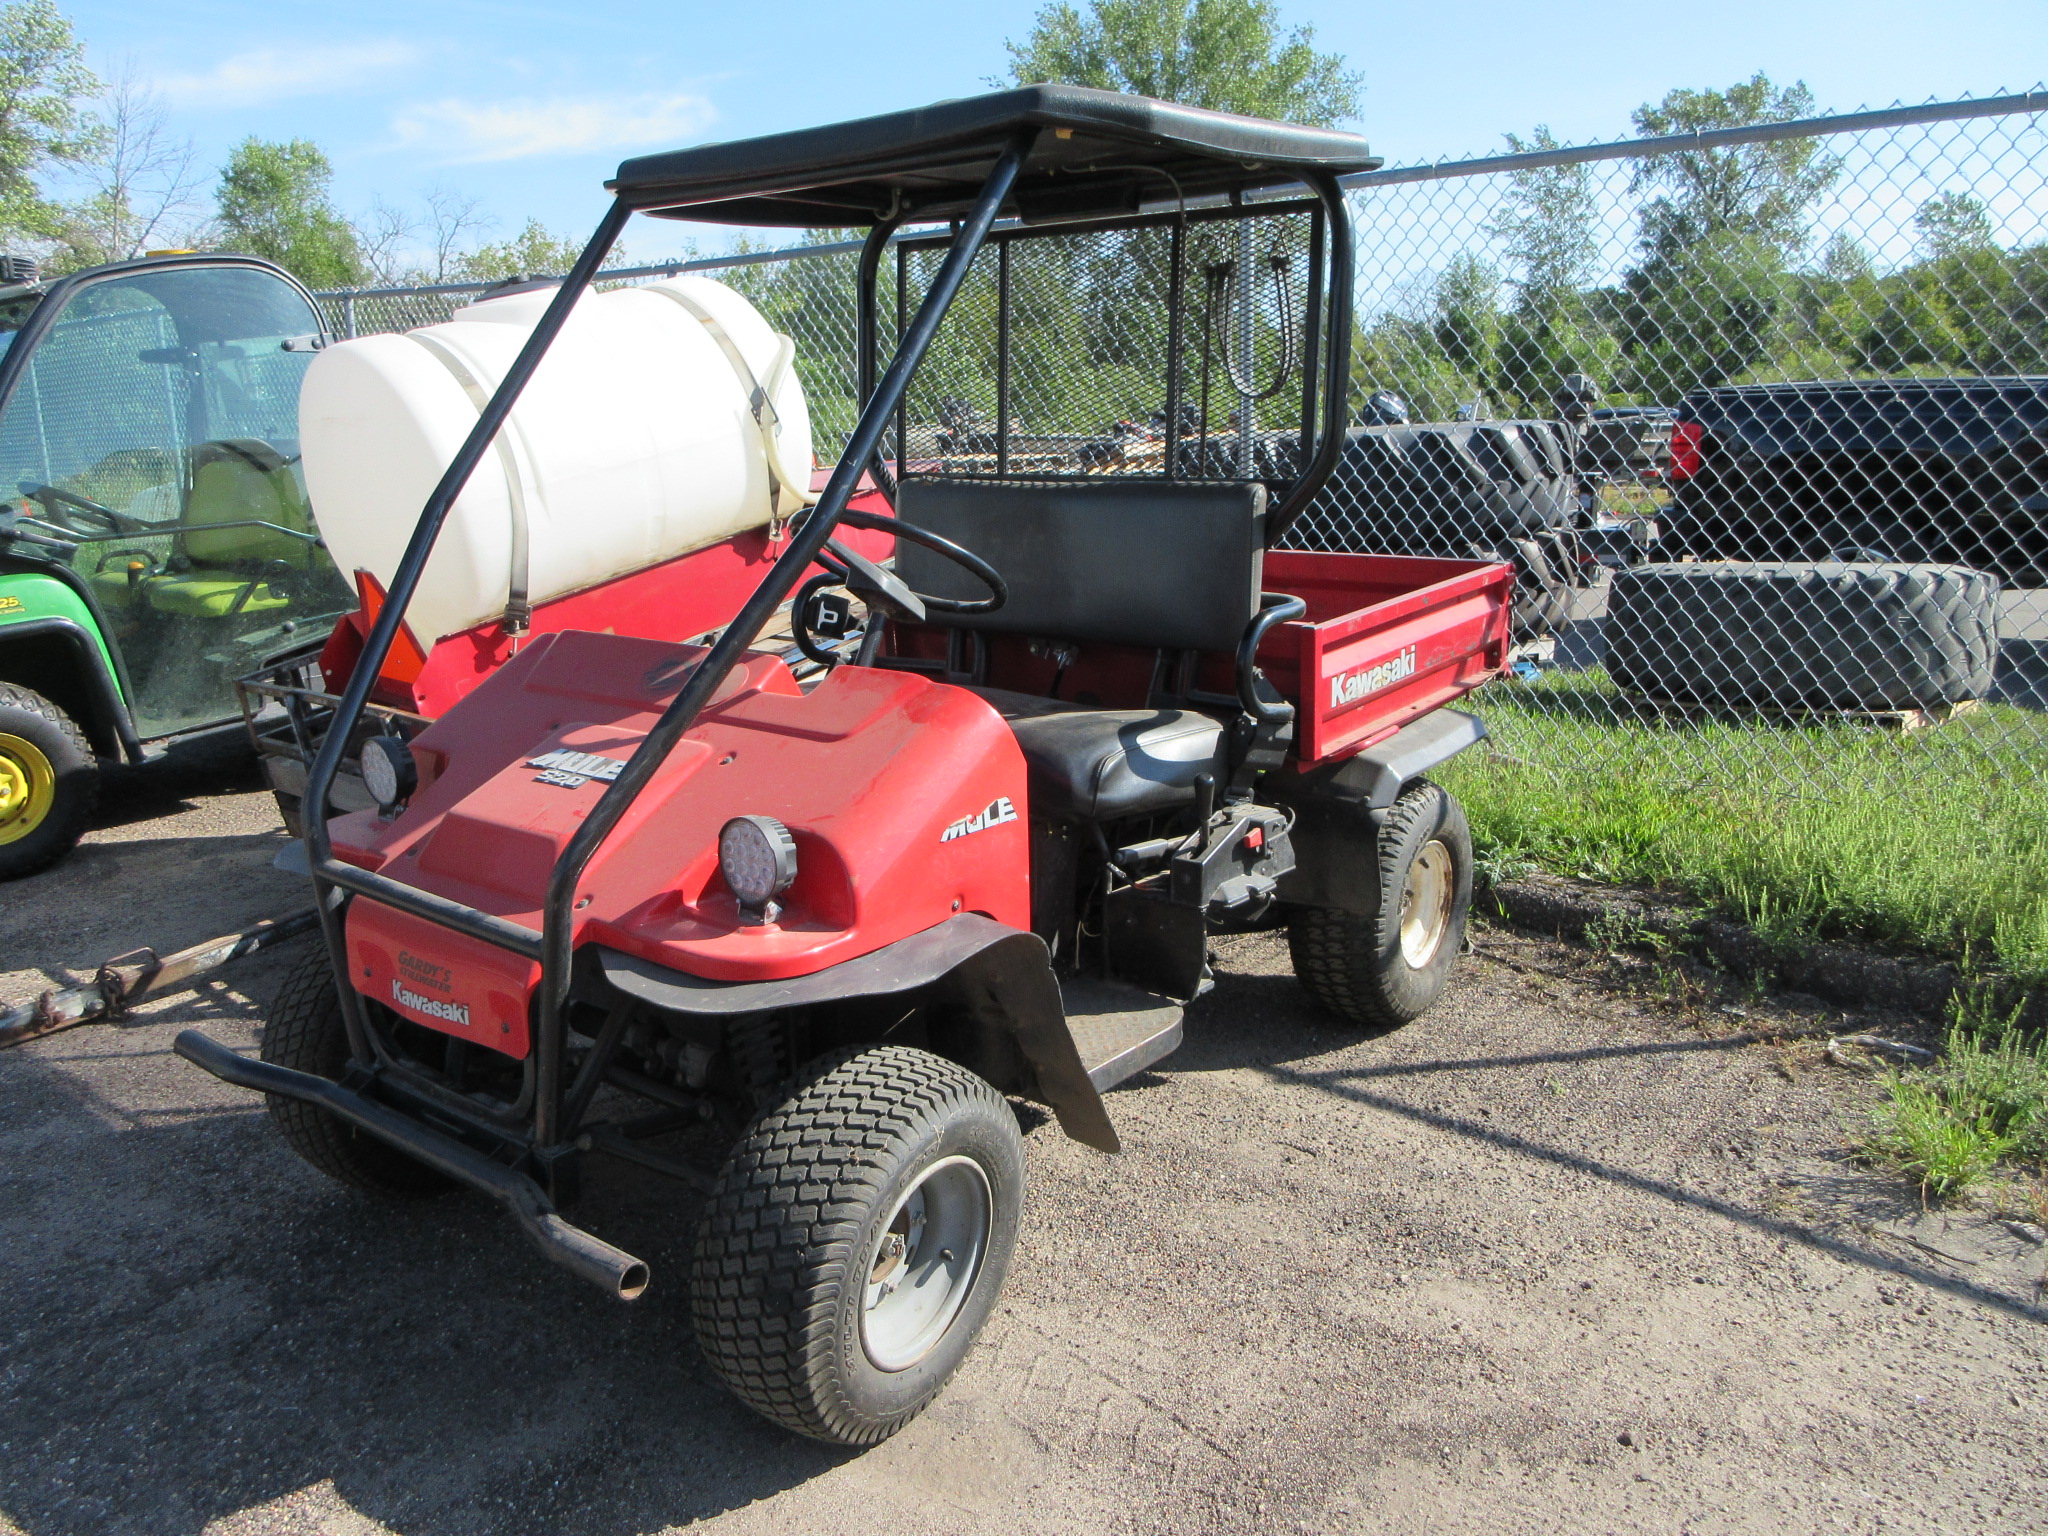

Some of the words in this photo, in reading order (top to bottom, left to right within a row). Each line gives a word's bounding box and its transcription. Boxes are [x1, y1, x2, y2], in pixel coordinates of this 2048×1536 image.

[1330, 644, 1416, 709] Kawasaki
[534, 767, 589, 789] 520
[940, 796, 1018, 843] MULE
[392, 979, 471, 1027] Kawasaki
[400, 966, 453, 993] STILLWATER
